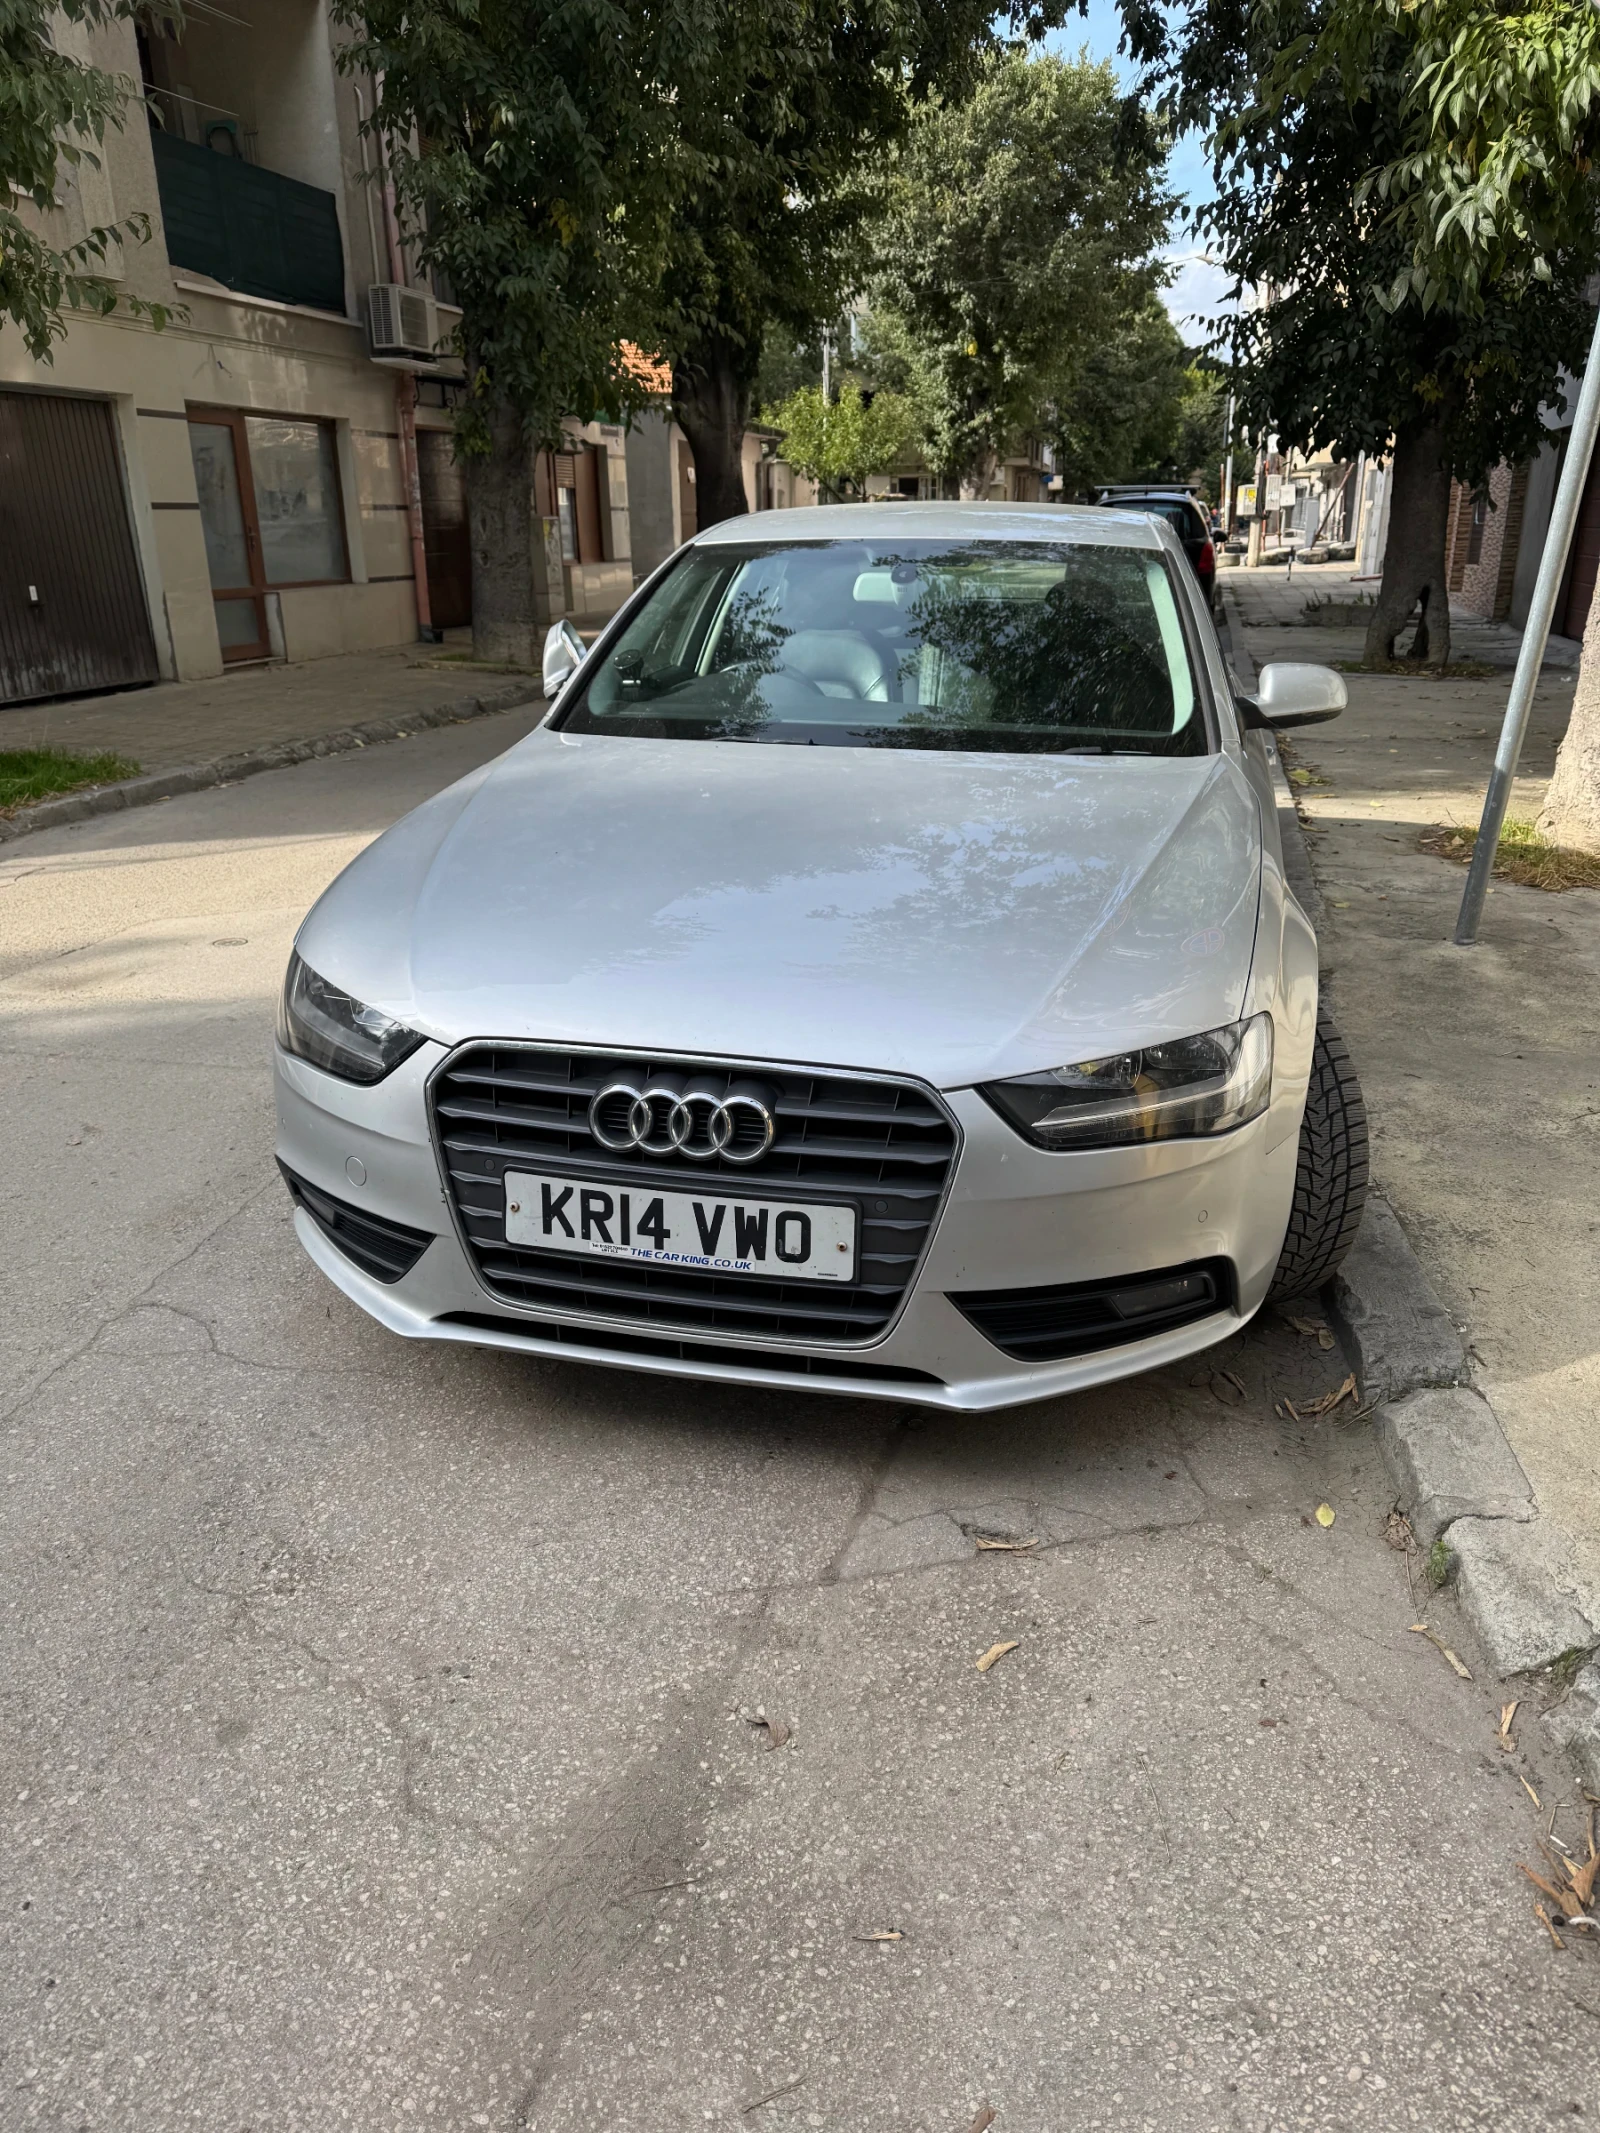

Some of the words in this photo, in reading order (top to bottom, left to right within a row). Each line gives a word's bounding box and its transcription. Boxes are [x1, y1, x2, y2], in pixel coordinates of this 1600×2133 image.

[541, 1182, 671, 1250] KR14
[692, 1201, 812, 1264] VWO
[630, 1247, 653, 1258] THE
